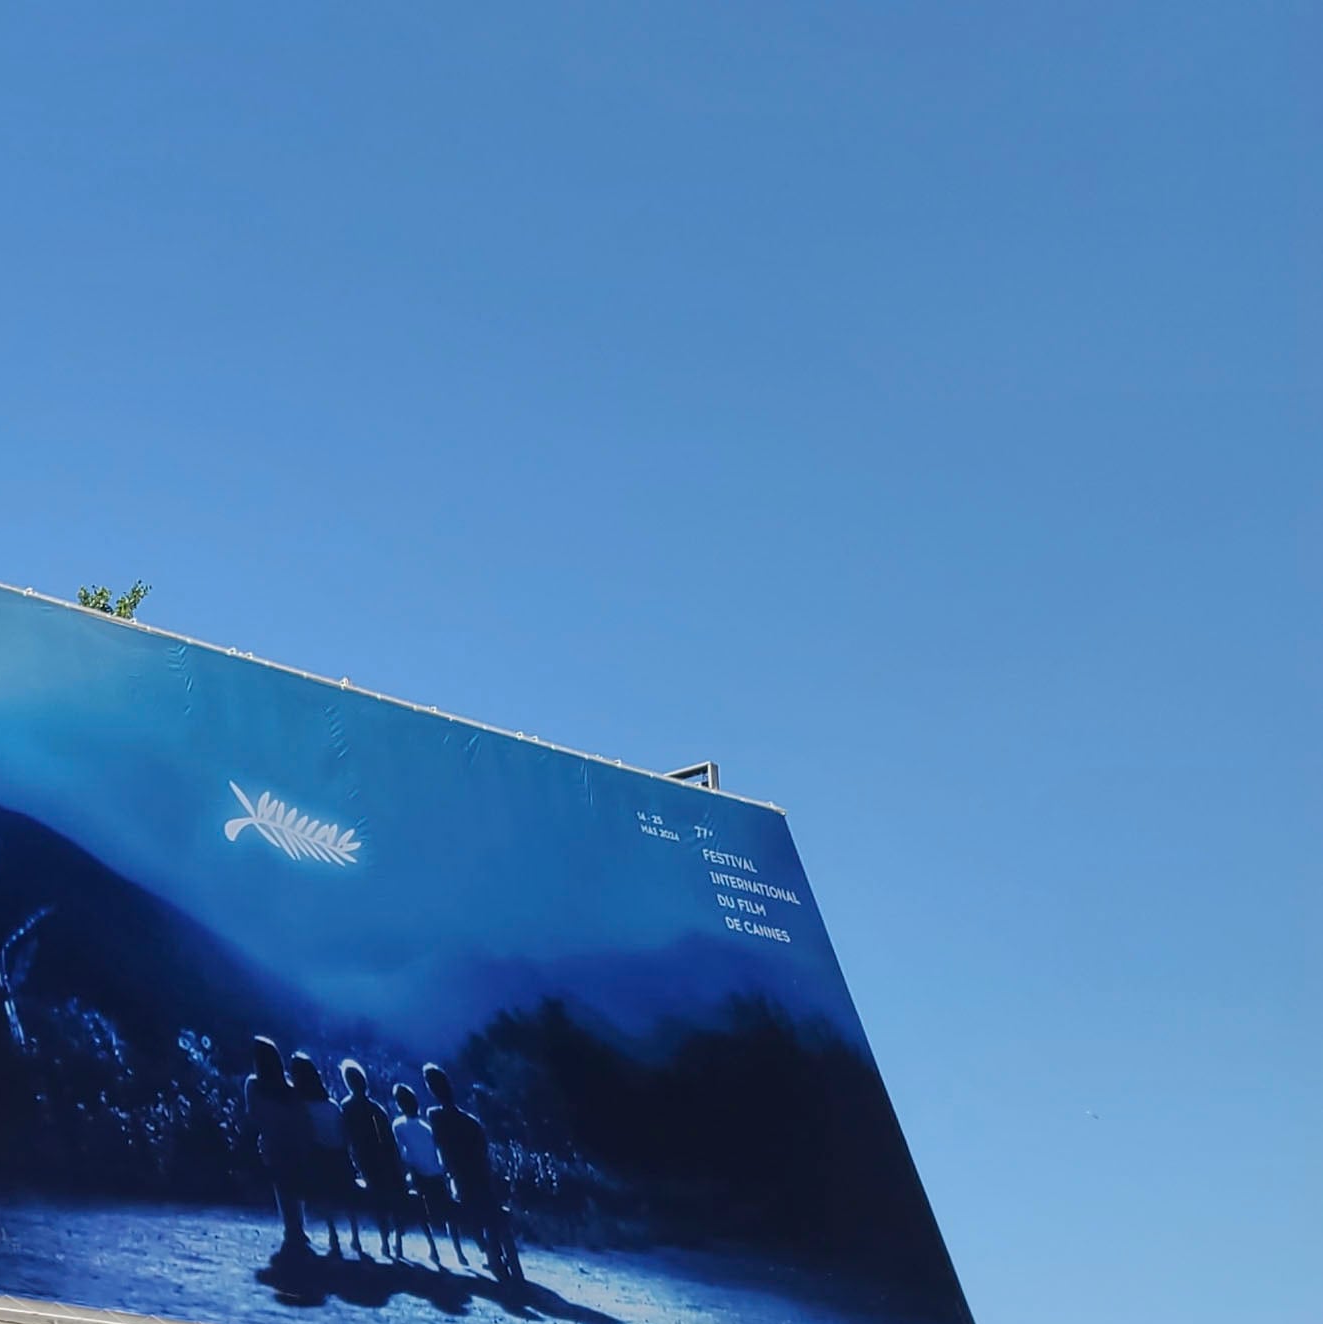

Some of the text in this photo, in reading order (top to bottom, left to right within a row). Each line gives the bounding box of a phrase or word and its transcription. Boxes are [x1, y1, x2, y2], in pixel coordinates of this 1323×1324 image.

[640, 824, 659, 837] MAI
[702, 848, 759, 874] FESTIVAL
[709, 871, 802, 906] INTERNATIONAL
[716, 893, 767, 917] DU FILM
[724, 916, 792, 943] DE CANNES
